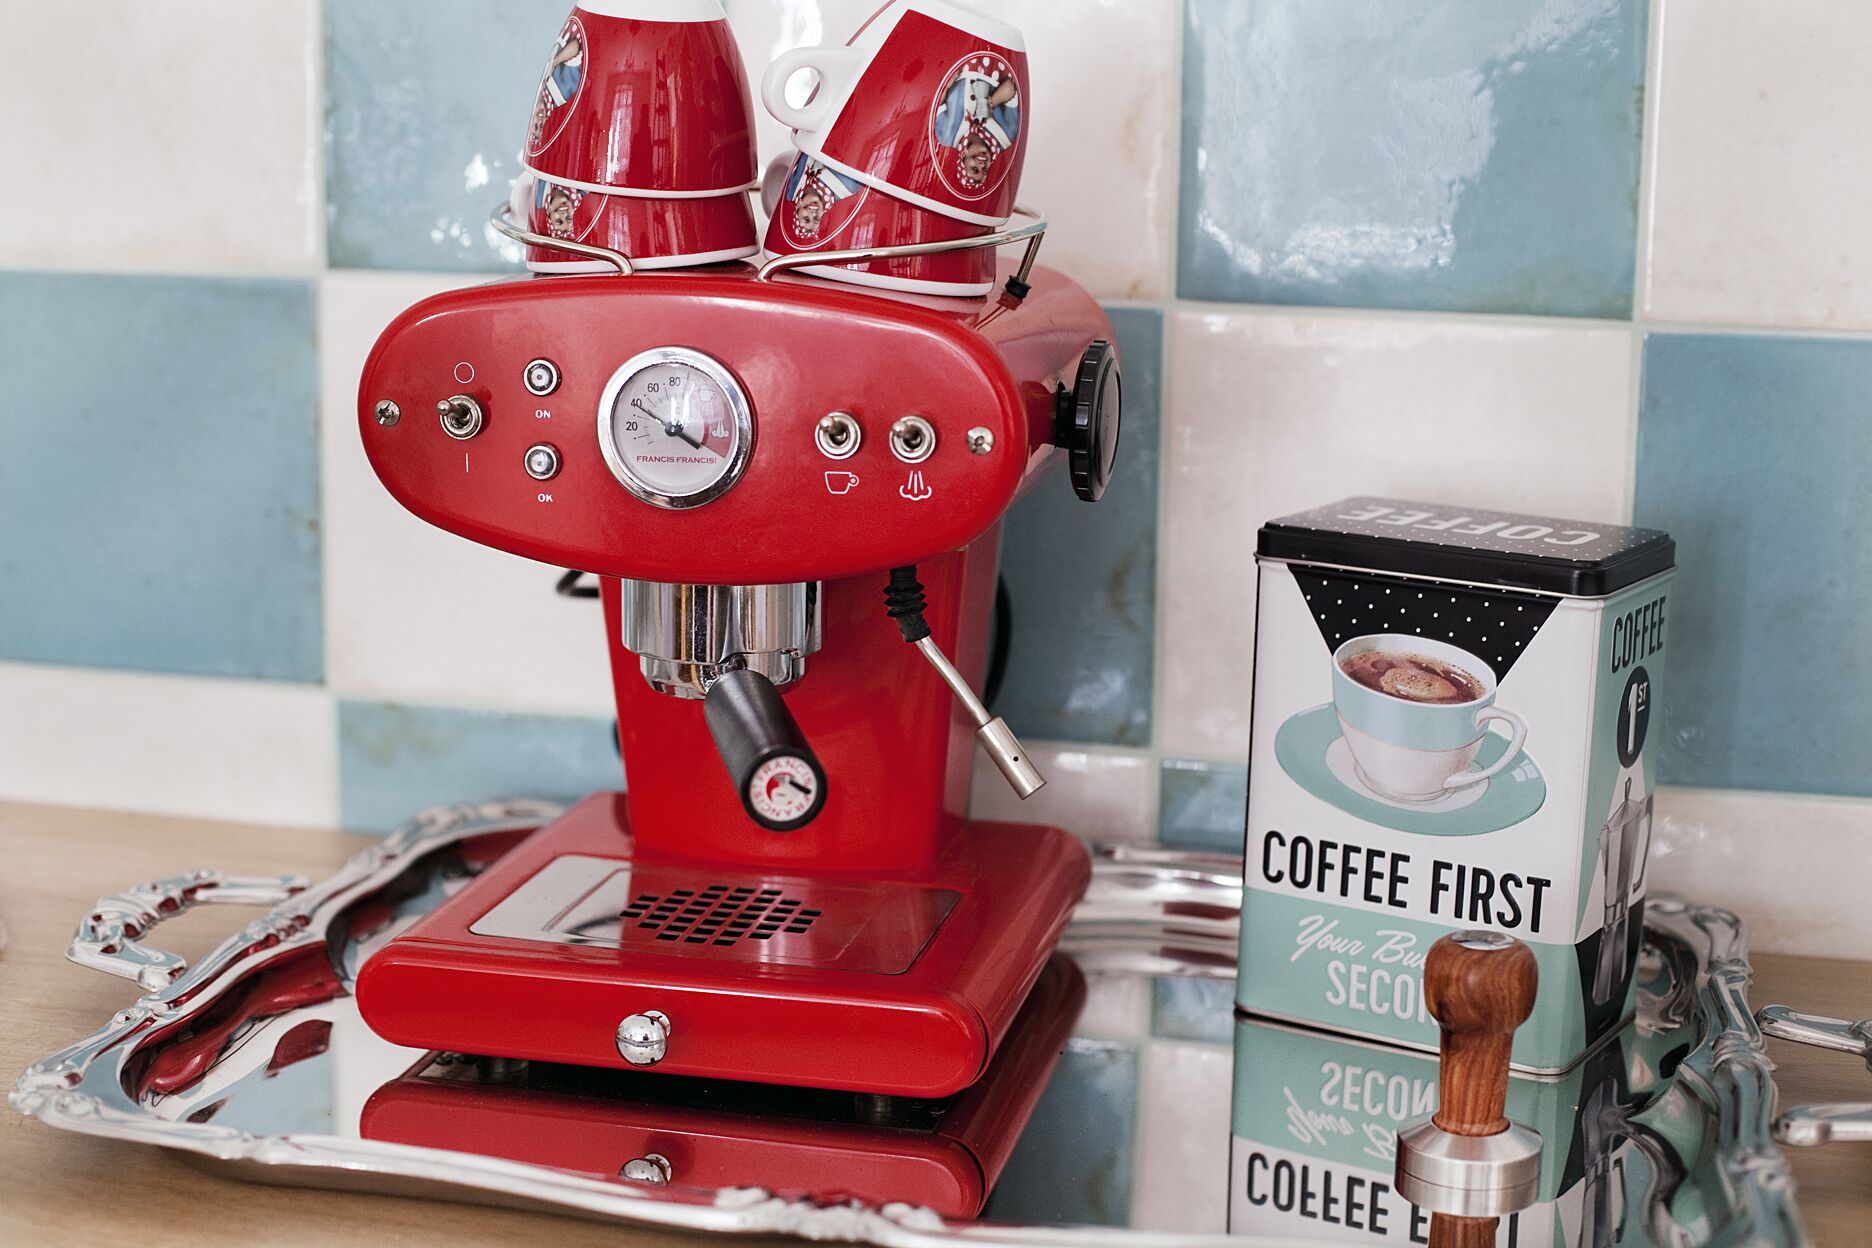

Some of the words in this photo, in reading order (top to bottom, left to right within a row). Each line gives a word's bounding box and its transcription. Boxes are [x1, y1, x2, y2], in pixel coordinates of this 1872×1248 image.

[669, 377, 681, 387] 80
[647, 383, 660, 393] 60
[630, 398, 643, 408] 40
[535, 409, 551, 419] ON
[626, 421, 639, 431] 20
[636, 455, 675, 463] FRANCIS
[537, 493, 553, 503] OK
[1337, 505, 1601, 545] COFFEE
[1611, 596, 1666, 674] COFFEE
[1262, 829, 1411, 909] COFFEE
[1429, 859, 1552, 933] FIRST
[1290, 914, 1366, 963] Your
[1371, 929, 1427, 970] Bu
